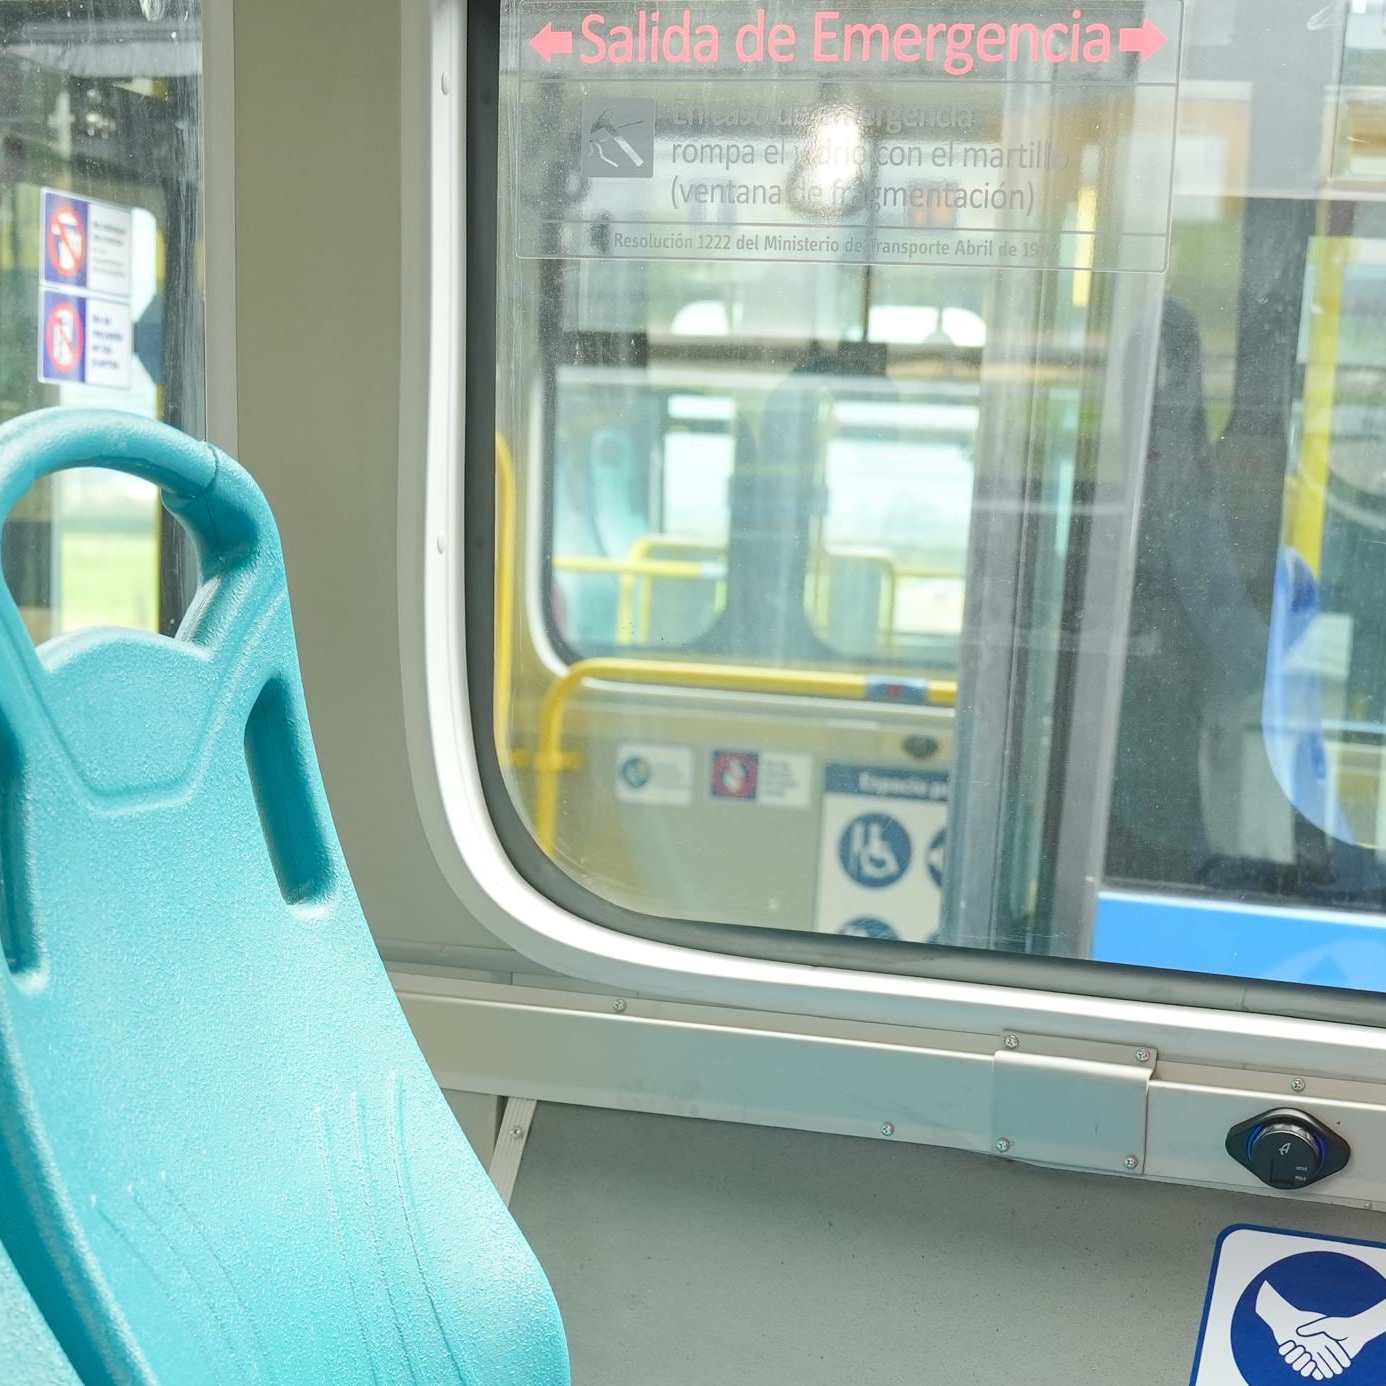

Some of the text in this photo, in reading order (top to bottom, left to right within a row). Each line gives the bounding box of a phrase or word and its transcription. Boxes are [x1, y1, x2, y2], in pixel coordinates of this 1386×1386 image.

[579, 8, 1112, 76] Salida de Emergencia
[671, 142, 756, 171] rompa
[763, 138, 785, 165] el
[876, 144, 923, 168] con
[931, 140, 955, 168] el
[670, 175, 783, 205] (ventana
[613, 232, 694, 250] Resolución
[697, 234, 732, 250] 1222
[736, 235, 761, 251] del
[763, 235, 840, 252] Ministerio
[844, 237, 864, 253] de
[869, 238, 950, 258] Transporte
[954, 240, 994, 257] Abril
[998, 240, 1019, 257] de
